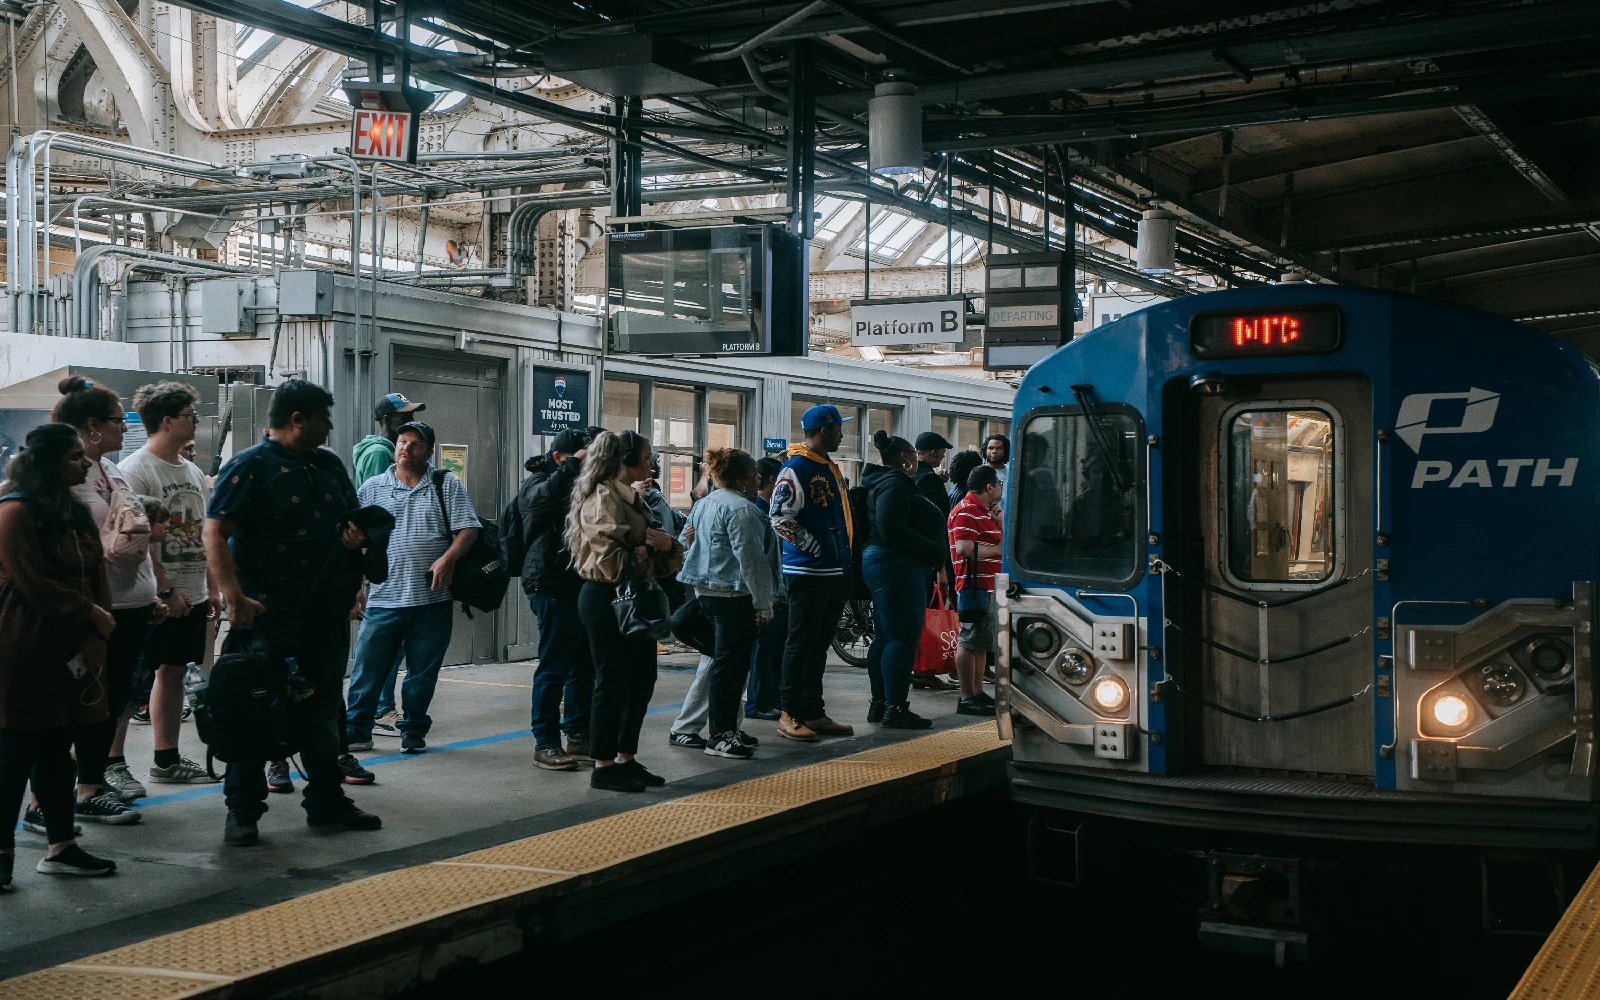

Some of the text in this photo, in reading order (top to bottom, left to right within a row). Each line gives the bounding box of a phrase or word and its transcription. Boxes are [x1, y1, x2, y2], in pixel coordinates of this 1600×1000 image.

[354, 112, 407, 157] EXIT
[992, 311, 1053, 322] DEPARTING
[855, 310, 959, 337] Platform B
[722, 342, 761, 351] PLATFORM B
[548, 399, 573, 409] MOST
[541, 410, 580, 421] TRUSTED
[1411, 458, 1579, 489] PATH
